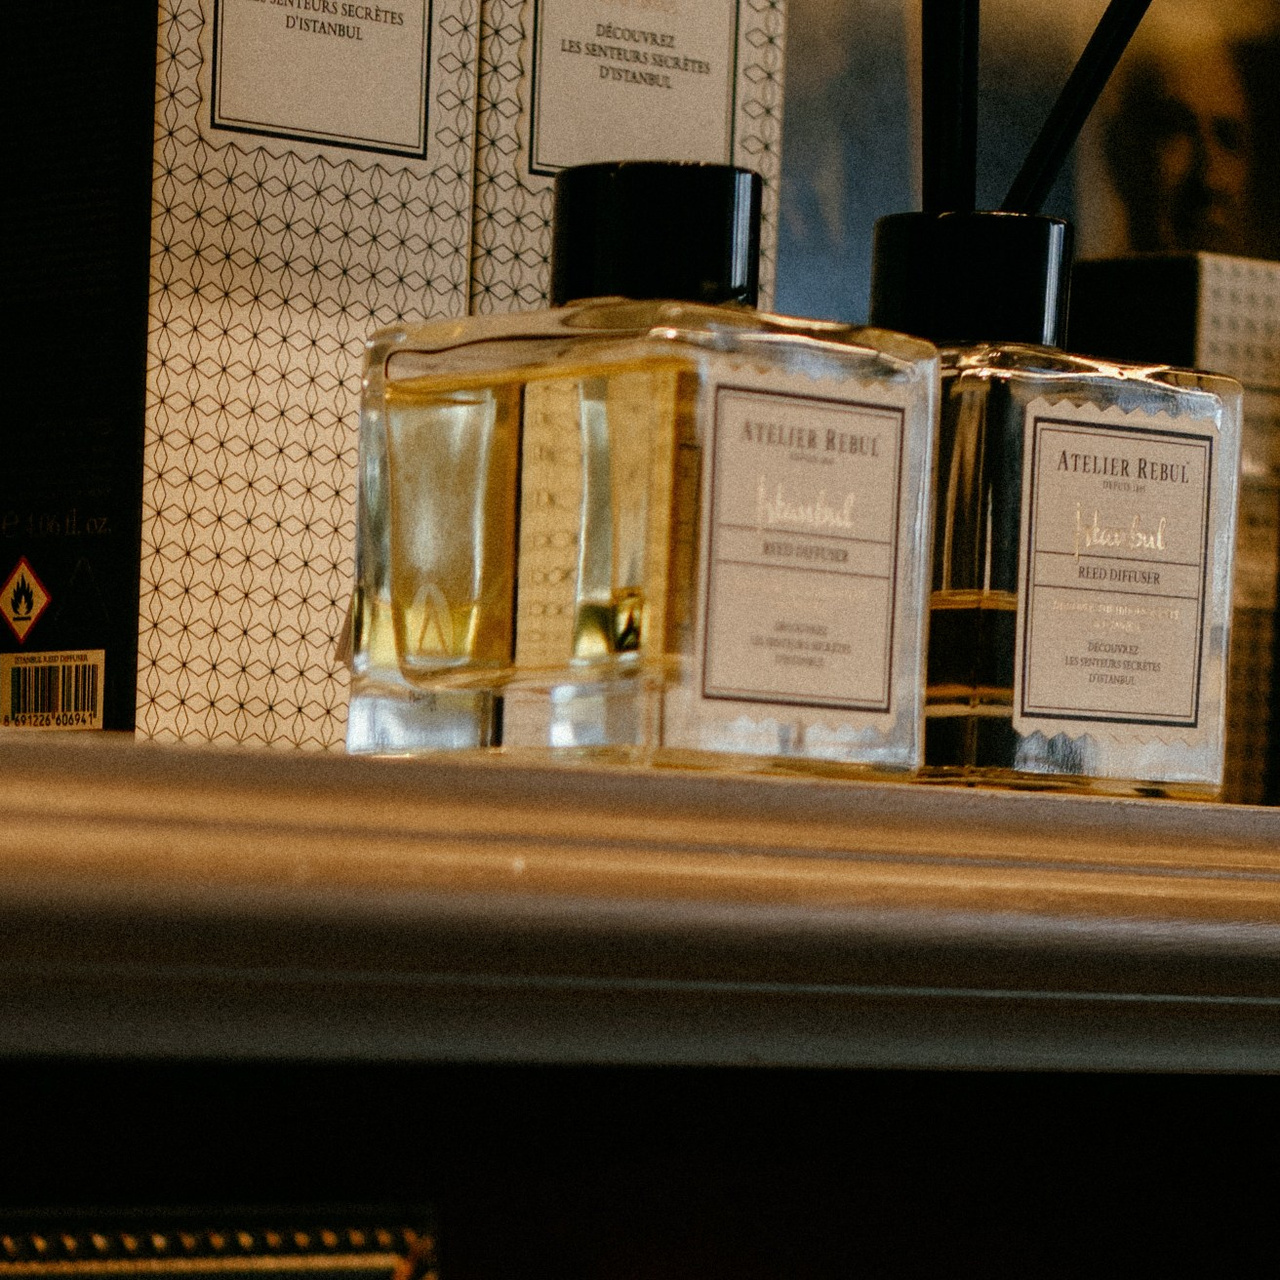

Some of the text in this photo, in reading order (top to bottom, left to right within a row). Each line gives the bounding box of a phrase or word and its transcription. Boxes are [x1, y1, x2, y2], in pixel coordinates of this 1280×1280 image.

[341, 3, 404, 26] SECRÈTES
[286, 15, 363, 41] D'ISTANBUL
[596, 22, 675, 48] DÉCOUVREZ
[561, 39, 582, 54] LES
[585, 42, 648, 64] SENTEURS
[600, 65, 672, 89] D'ISTANBUL
[743, 421, 817, 449] ATELIER
[1057, 450, 1189, 483] ATELIER REBUL
[1078, 565, 1160, 585] REED DIFFUSER
